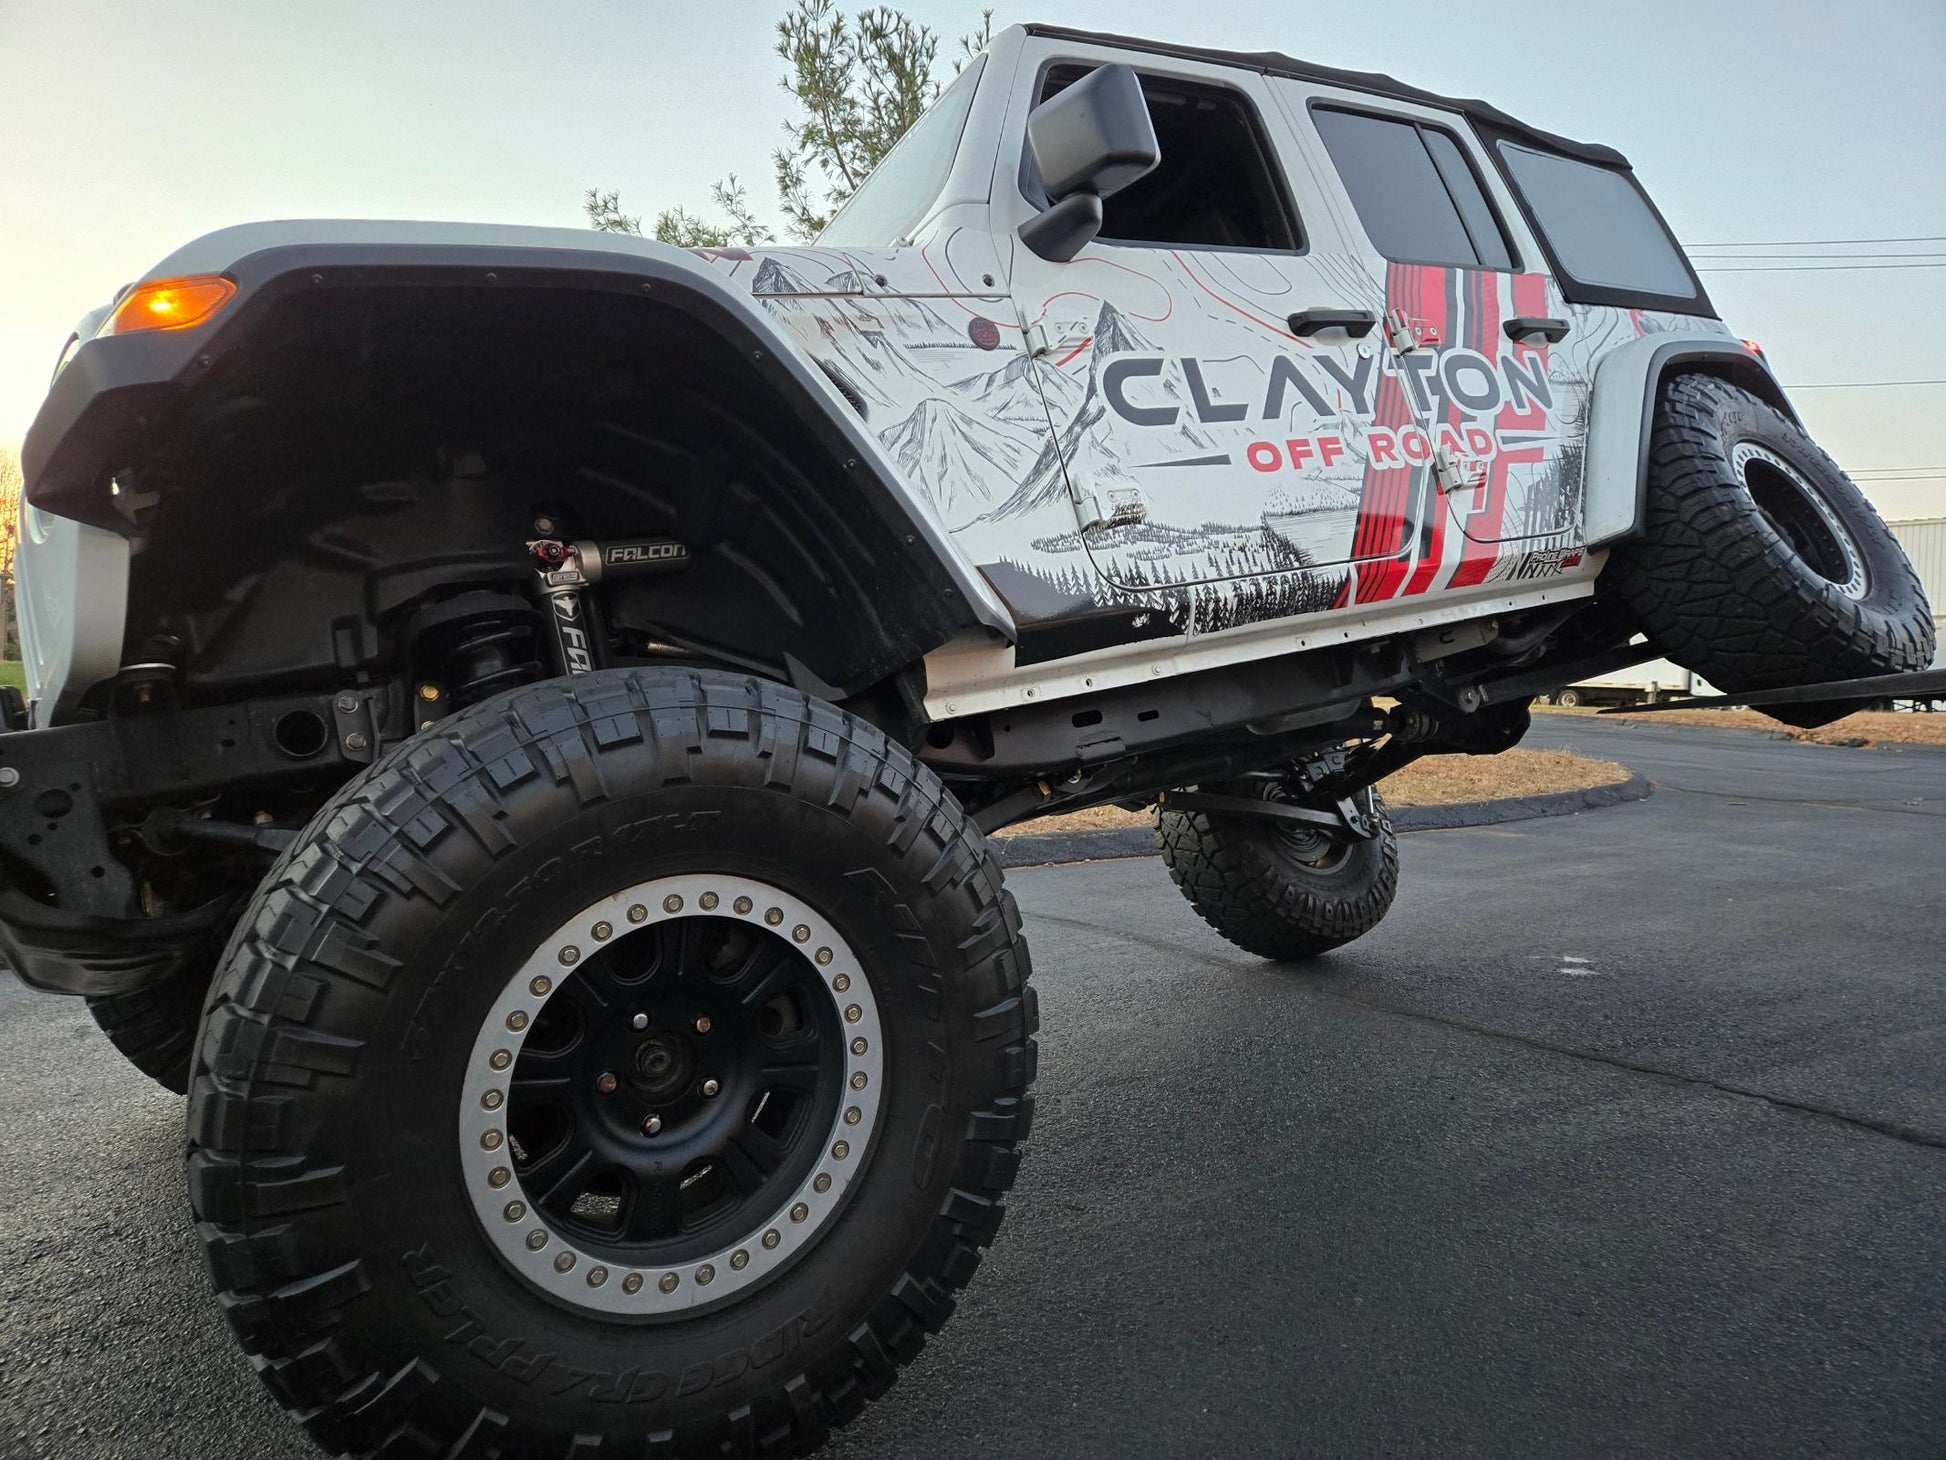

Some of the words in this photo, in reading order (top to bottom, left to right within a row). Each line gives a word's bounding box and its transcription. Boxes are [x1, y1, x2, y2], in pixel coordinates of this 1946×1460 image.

[1103, 354, 1552, 427] CLAYTON
[1247, 436, 1345, 473] OFF
[1367, 428, 1493, 463] ROAD
[611, 544, 688, 562] FALCON
